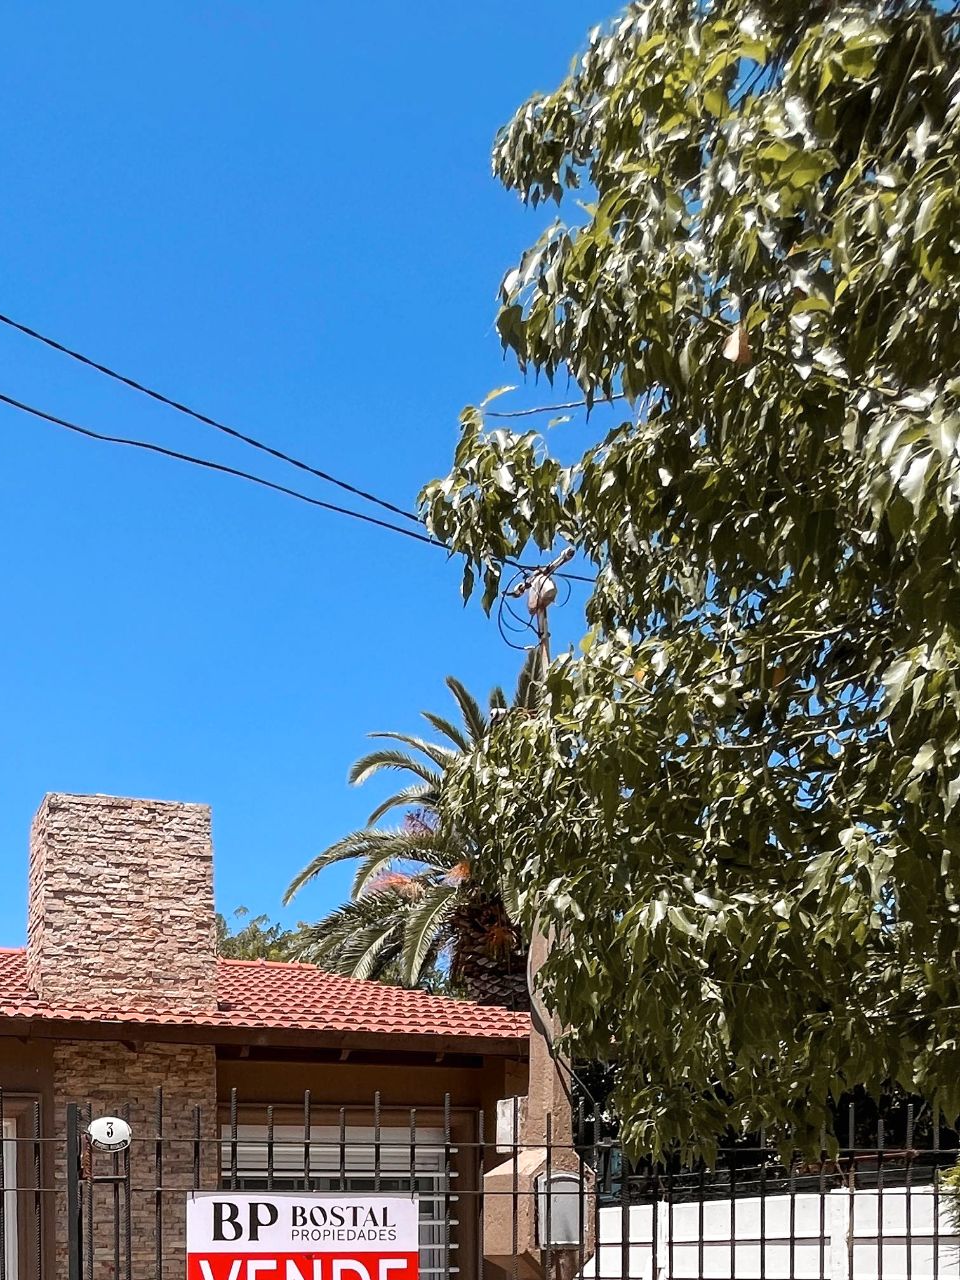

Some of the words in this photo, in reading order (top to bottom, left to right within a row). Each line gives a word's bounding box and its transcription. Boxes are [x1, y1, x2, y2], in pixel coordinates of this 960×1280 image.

[106, 1121, 114, 1138] 3
[212, 1202, 279, 1242] BP
[291, 1205, 397, 1228] BOSTAL
[291, 1229, 397, 1241] PROPIEDADES
